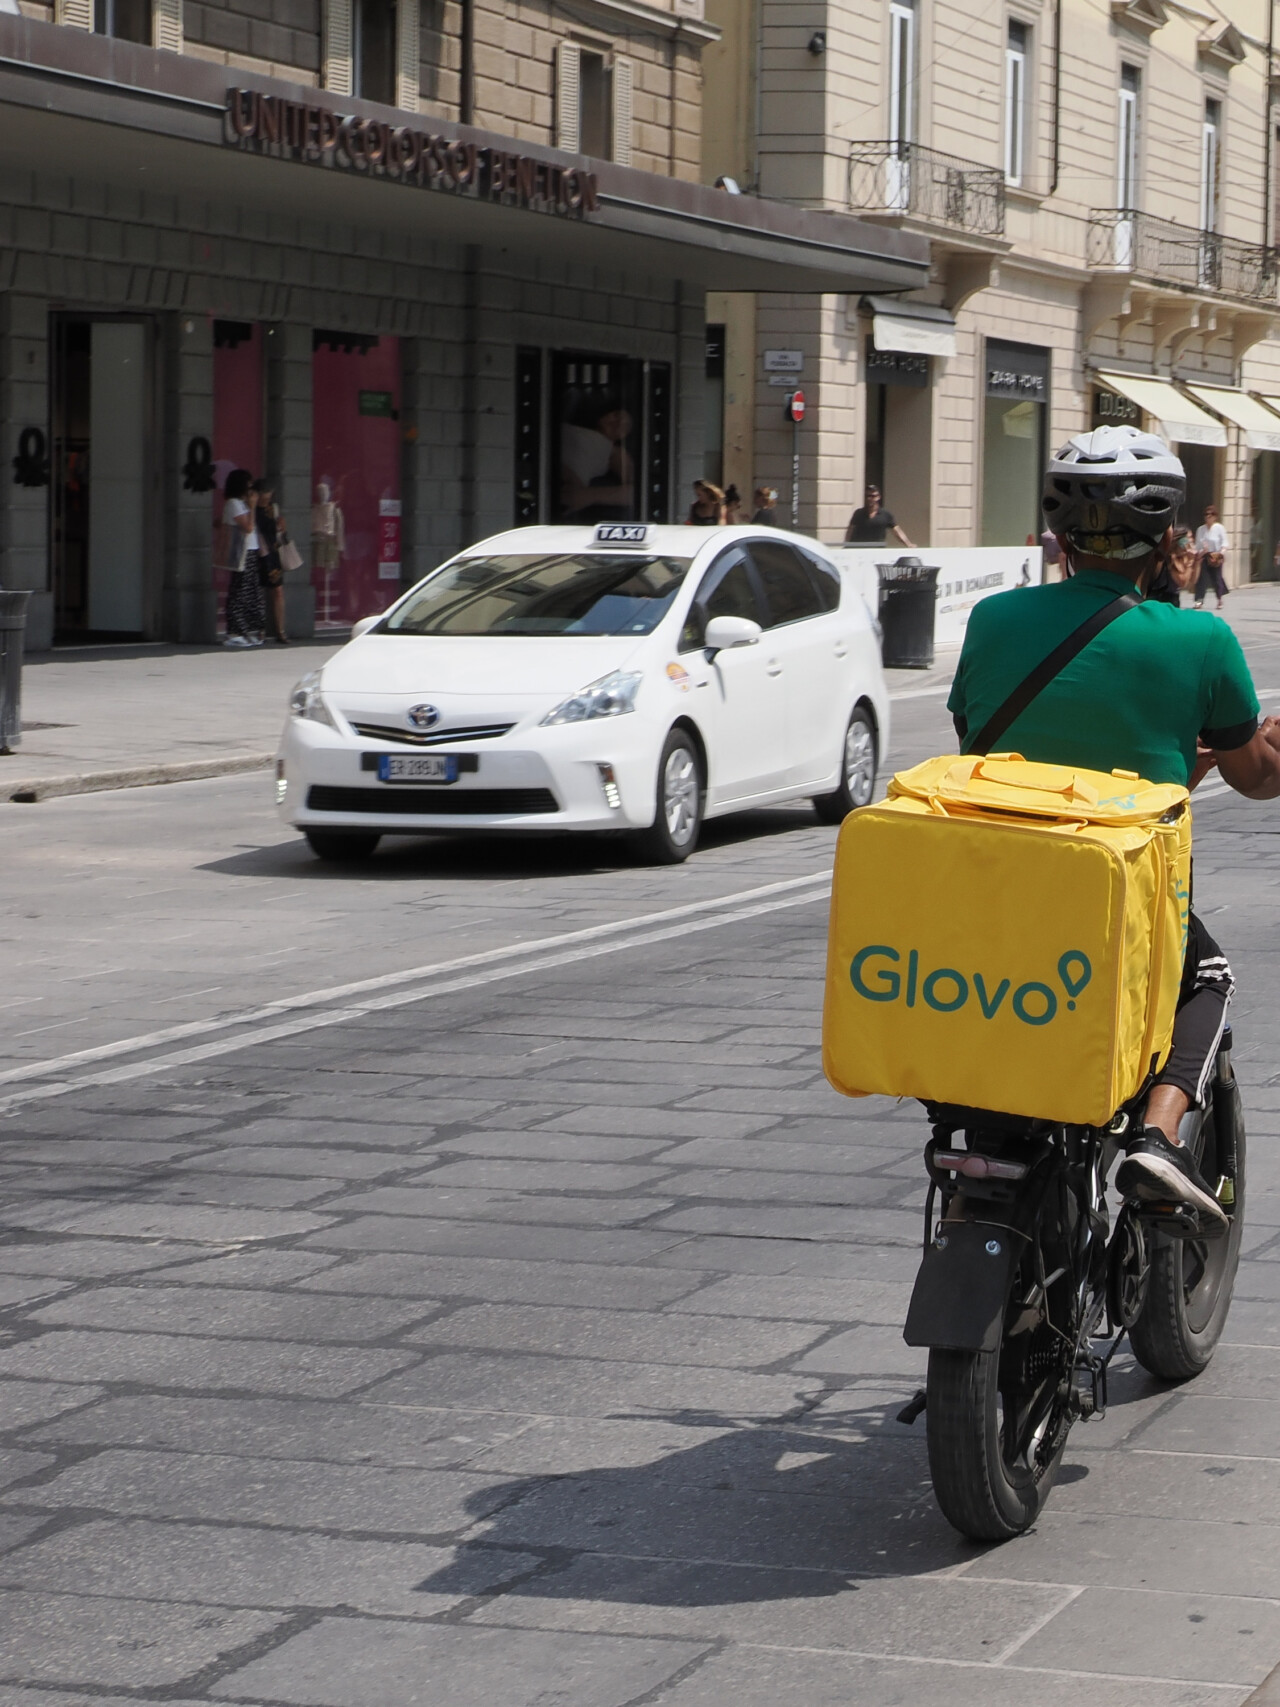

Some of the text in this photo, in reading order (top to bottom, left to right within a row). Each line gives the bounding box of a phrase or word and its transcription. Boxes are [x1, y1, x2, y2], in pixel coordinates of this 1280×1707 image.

[227, 87, 338, 151] UNITED
[339, 114, 447, 178] COLORS
[446, 138, 481, 186] OF
[867, 353, 928, 373] ZARA HOME
[990, 370, 1044, 390] ZARA HOME
[599, 526, 647, 540] TAXI
